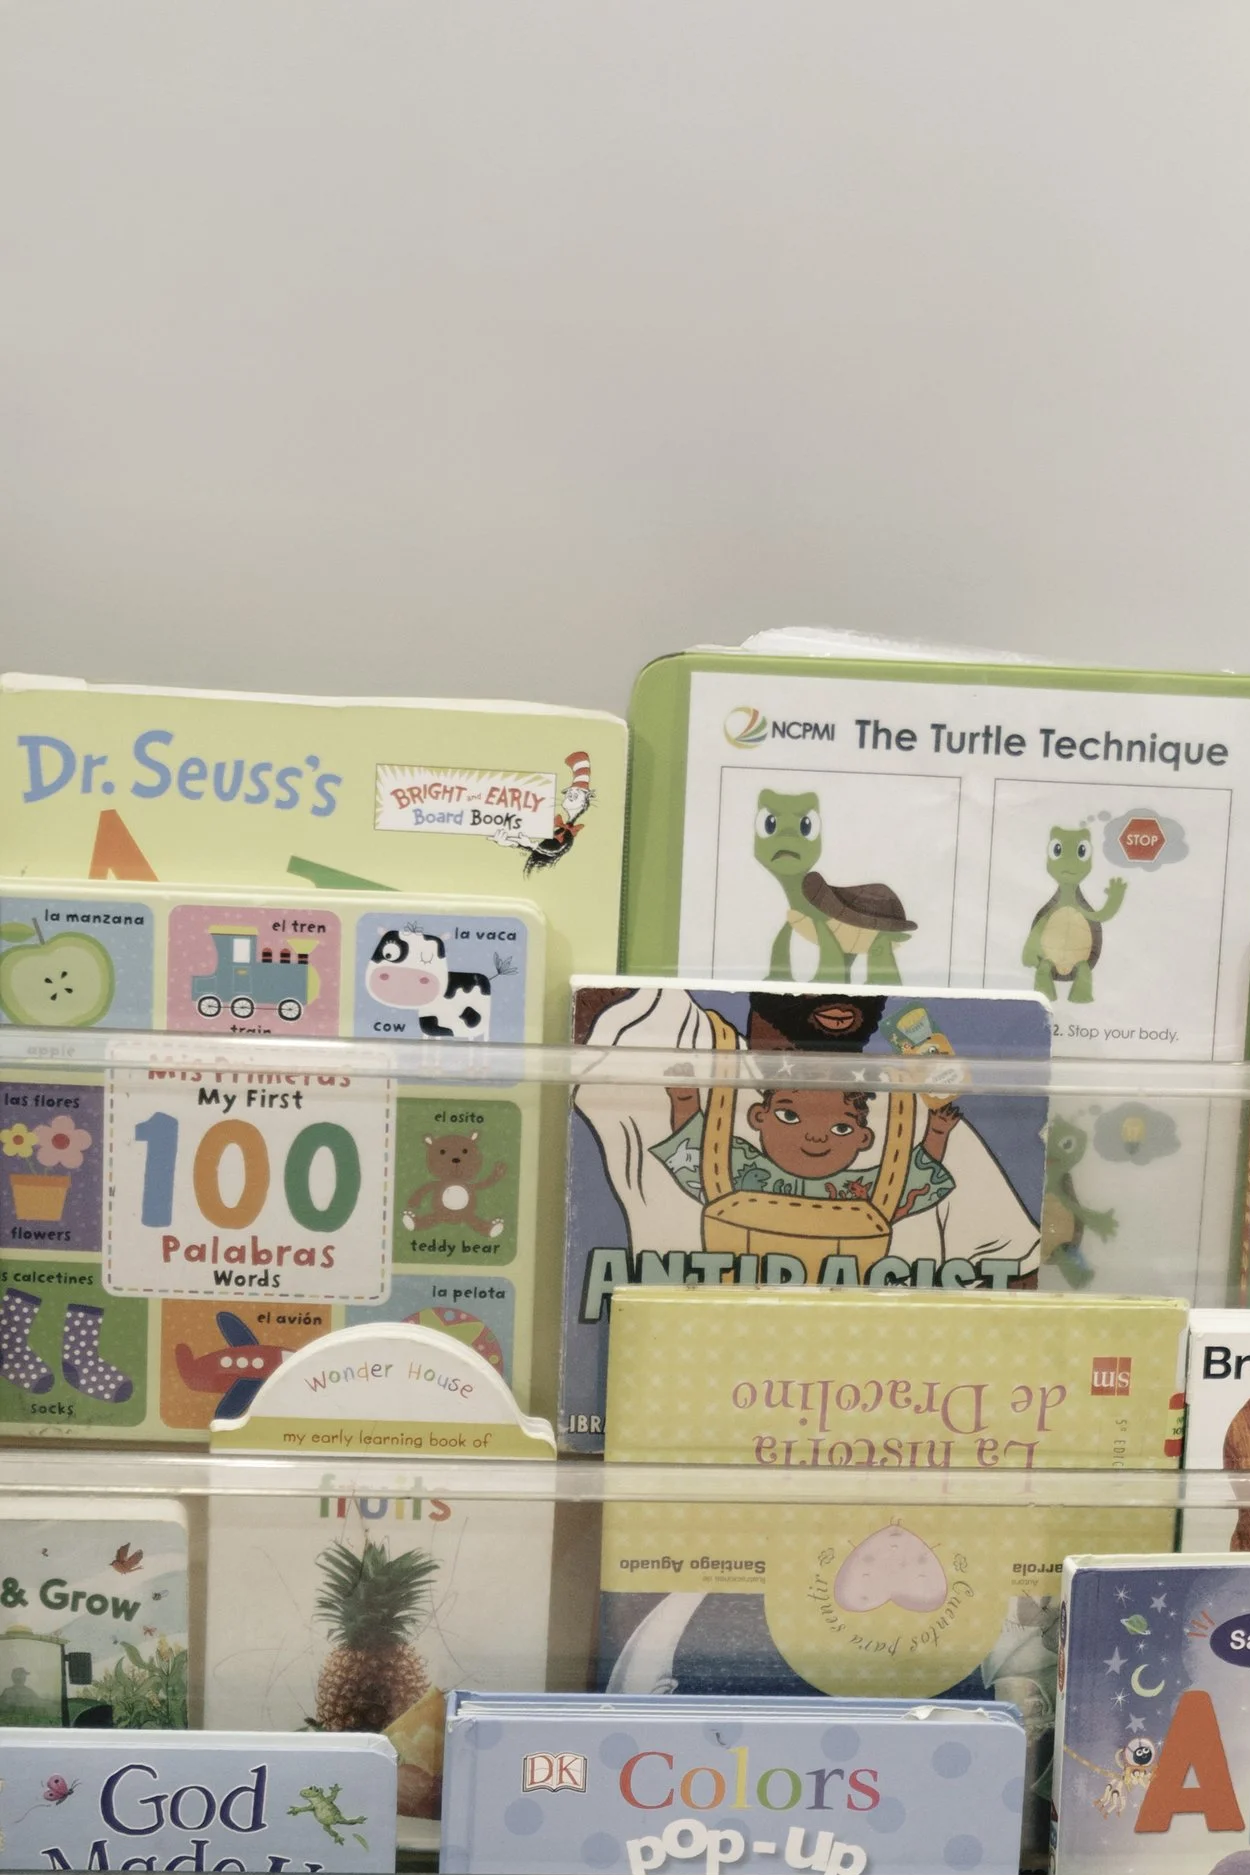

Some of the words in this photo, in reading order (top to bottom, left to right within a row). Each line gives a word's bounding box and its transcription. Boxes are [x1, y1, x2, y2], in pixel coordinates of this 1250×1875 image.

[772, 720, 836, 741] NCPMI
[854, 720, 918, 753] The
[930, 724, 1026, 757] Turtle
[1039, 728, 1230, 771] Technique
[16, 734, 116, 804] Dr.
[130, 729, 343, 818] Seuss's
[390, 782, 467, 809] BRIGHT
[466, 793, 482, 801] and
[485, 786, 546, 812] EARLY
[413, 809, 464, 825] Board
[470, 809, 522, 830] Books
[1125, 833, 1158, 848] STOP
[45, 910, 60, 925] la
[64, 911, 144, 926] manzana
[272, 920, 287, 932] el
[292, 921, 326, 935] tren
[455, 927, 471, 941] la
[475, 929, 517, 942] vaca
[374, 1021, 405, 1033] cow
[1067, 1024, 1098, 1040] Stop
[1102, 1029, 1135, 1043] your
[1139, 1026, 1180, 1041] body.
[34, 1095, 80, 1108] flores
[198, 1088, 238, 1114] My
[246, 1089, 303, 1109] First
[435, 1111, 448, 1123] el
[450, 1111, 484, 1124] osito
[134, 1111, 361, 1233] 100
[11, 1227, 71, 1242] flowers
[161, 1234, 336, 1269] Palabras
[410, 1239, 456, 1256] teddy
[461, 1240, 500, 1254] bear
[14, 1272, 93, 1285] calcetines
[213, 1269, 281, 1289] Words
[432, 1286, 448, 1299] la
[451, 1288, 506, 1303] pelota
[257, 1311, 273, 1324] el
[277, 1311, 323, 1326] avión
[304, 1362, 394, 1393] Wonder
[408, 1362, 476, 1399] House
[30, 1402, 74, 1416] socks
[732, 1381, 989, 1435] Dracolino
[1013, 1384, 1068, 1432] de
[283, 1433, 306, 1447] my
[311, 1431, 354, 1450] early
[359, 1431, 423, 1450] learning
[429, 1432, 465, 1448] book
[472, 1432, 492, 1448] of
[620, 1556, 684, 1573] Aguado
[690, 1556, 766, 1573] Santiago
[39, 1577, 141, 1623] Grow
[807, 1574, 846, 1633] sentir
[910, 1580, 975, 1652] Cuentos
[850, 1633, 902, 1657] para
[528, 1754, 584, 1786] DK
[619, 1746, 881, 1812] Colors
[99, 1764, 268, 1836] God
